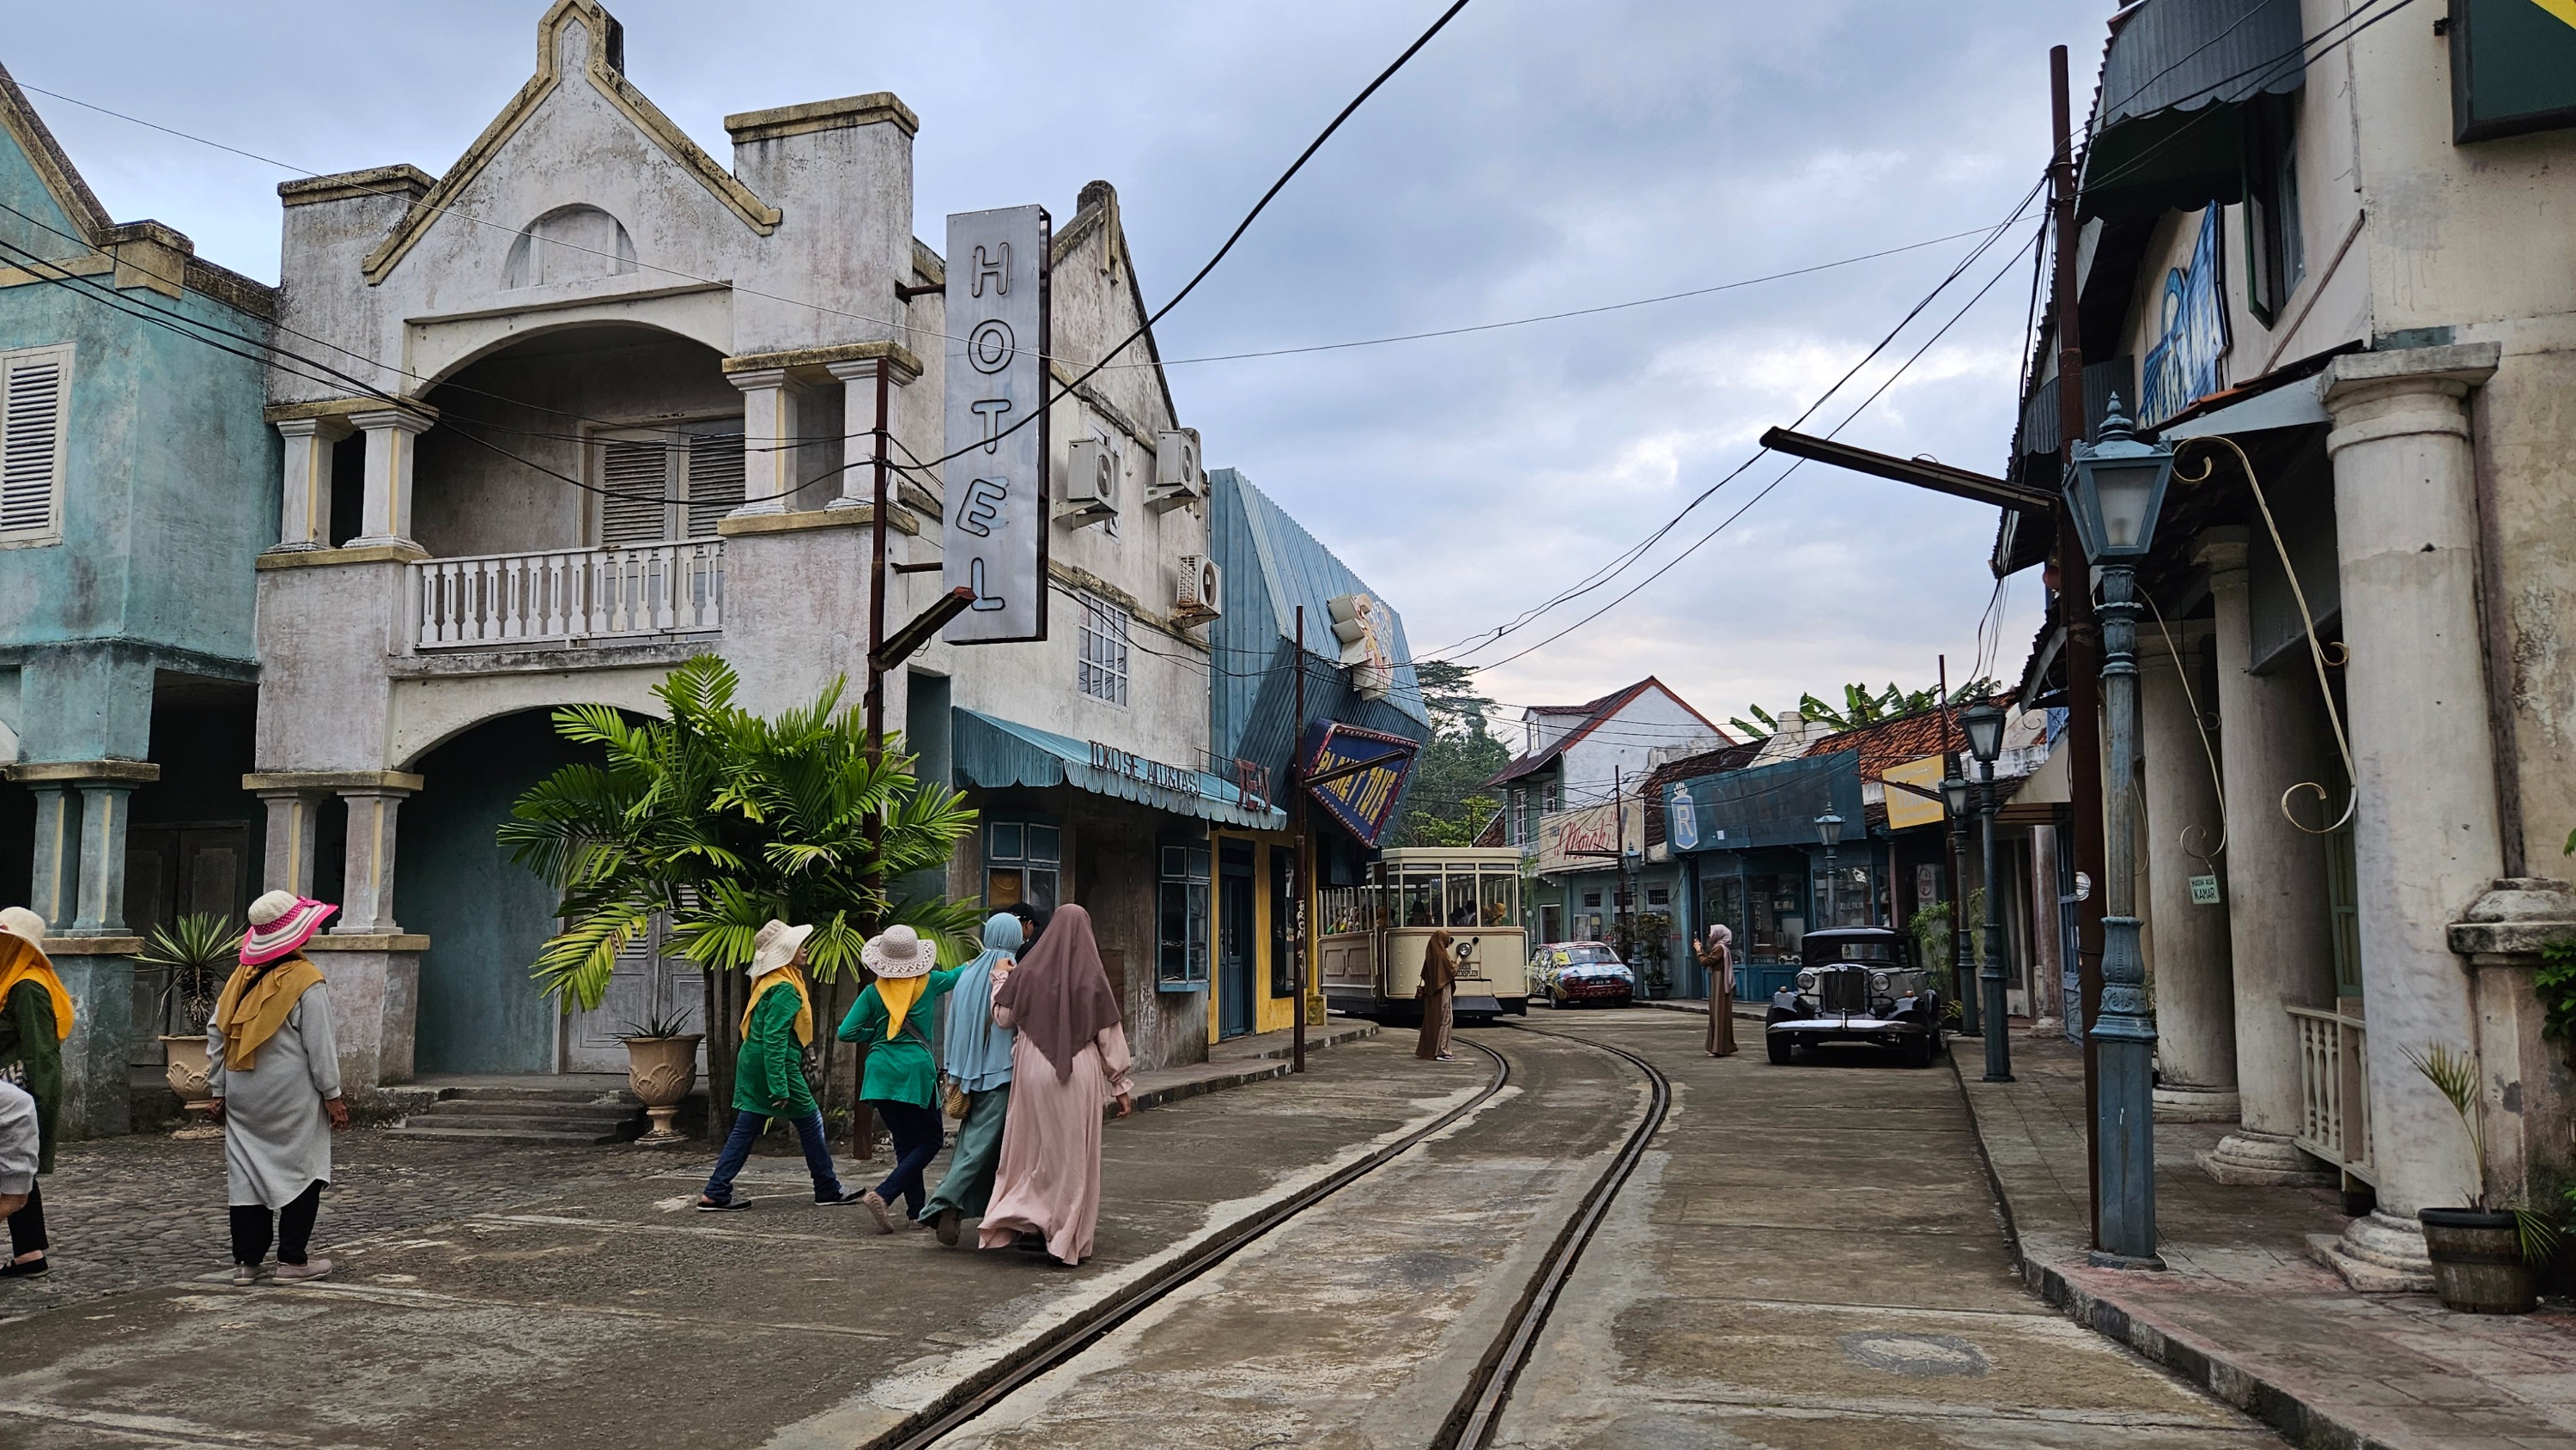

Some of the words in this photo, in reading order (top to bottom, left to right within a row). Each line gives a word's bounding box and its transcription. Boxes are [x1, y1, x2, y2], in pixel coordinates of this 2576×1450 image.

[956, 241, 1015, 611] HOTEL
[1353, 766, 1398, 826] TOYS
[1676, 804, 1694, 838] R
[2193, 887, 2216, 901] KAMAR
